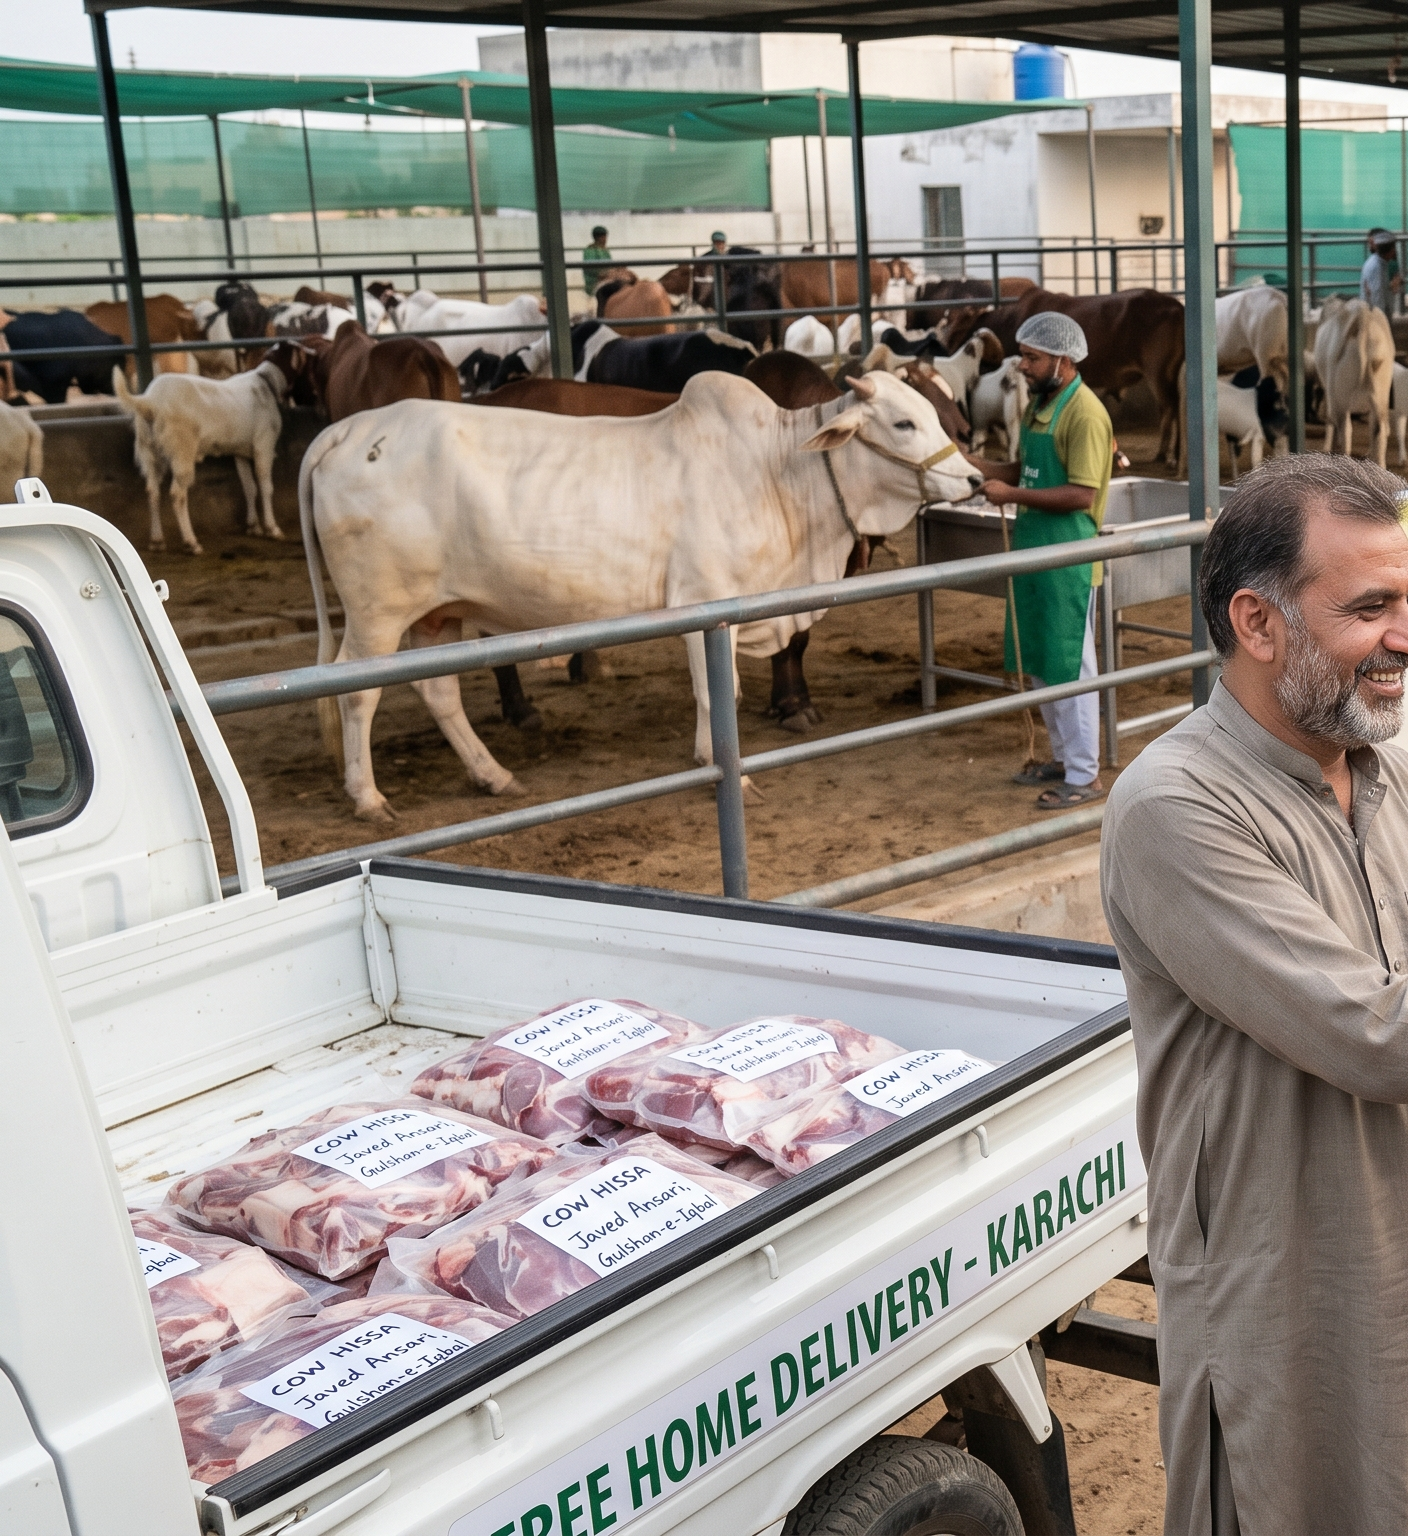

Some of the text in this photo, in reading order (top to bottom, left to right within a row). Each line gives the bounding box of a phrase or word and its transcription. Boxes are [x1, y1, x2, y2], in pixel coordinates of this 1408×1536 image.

[514, 1025, 550, 1045] COW
[863, 1070, 900, 1096] COW
[314, 1113, 417, 1154] COW HISSA
[335, 1121, 455, 1165] Javed Ansari,
[543, 1165, 651, 1228] COW HISSA
[568, 1182, 691, 1250] Javed Ansari,
[598, 1194, 718, 1267] Gulshan-e-Iqbal
[271, 1323, 400, 1396] COW HISSA
[491, 1463, 617, 1536] EE
[625, 1371, 762, 1510] HOME
[770, 1247, 953, 1417] DELIVERY
[986, 1140, 1126, 1277] KARACHI
[294, 1332, 447, 1410] Javed Ansari,
